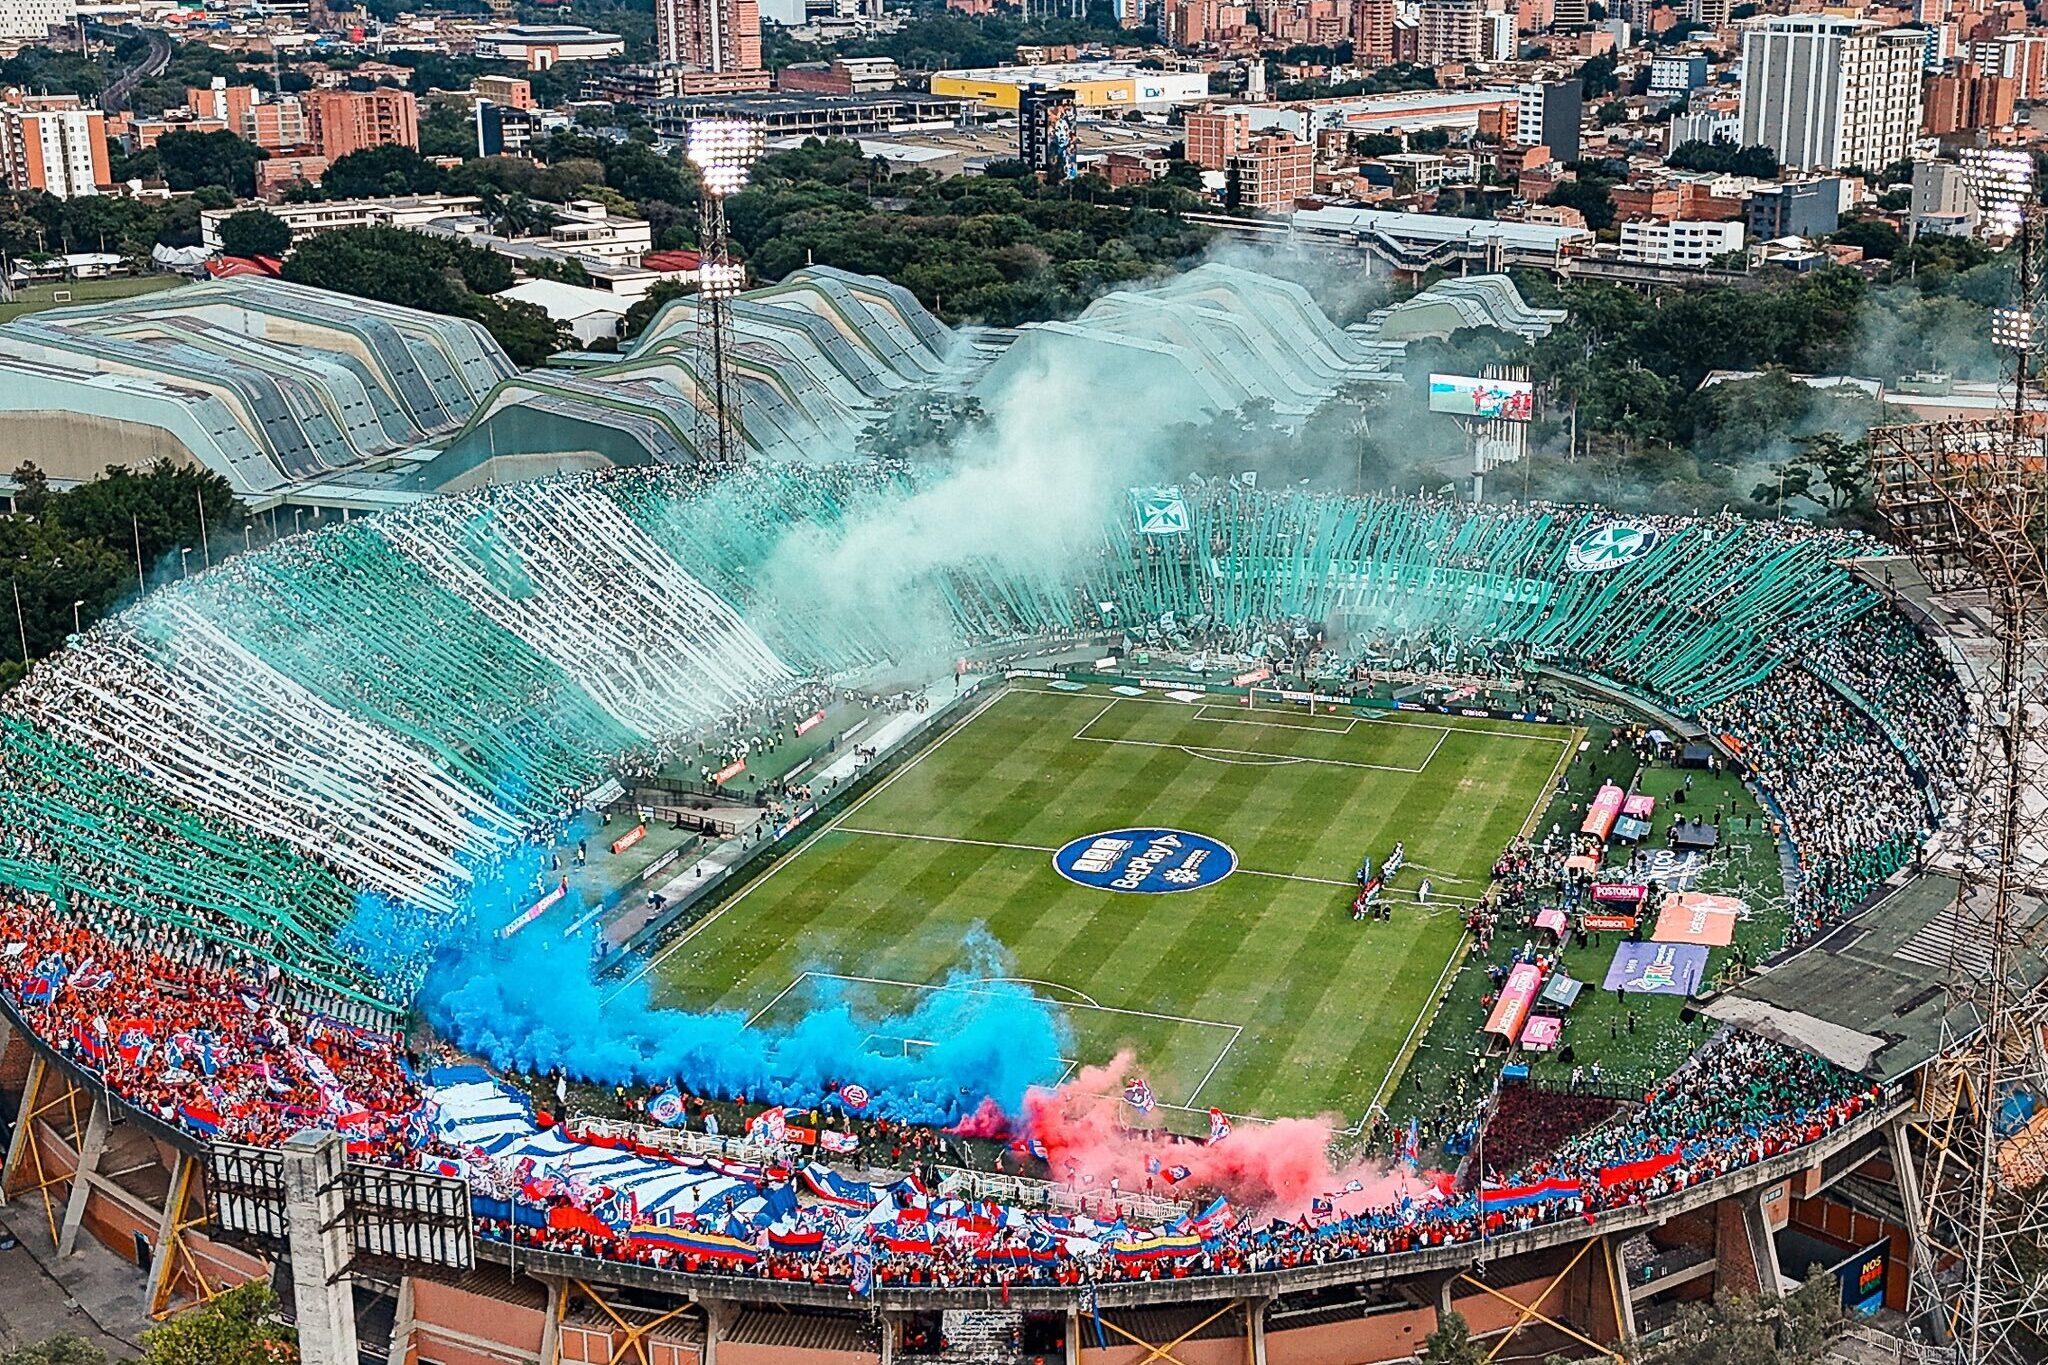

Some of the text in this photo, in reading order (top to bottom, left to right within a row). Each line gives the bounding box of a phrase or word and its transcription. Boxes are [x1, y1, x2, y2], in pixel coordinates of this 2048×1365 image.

[1110, 842, 1174, 889] BetPlay
[1596, 886, 1640, 898] POSTOBON
[1584, 917, 1627, 928] betsson
[1862, 1255, 1882, 1275] NOS
